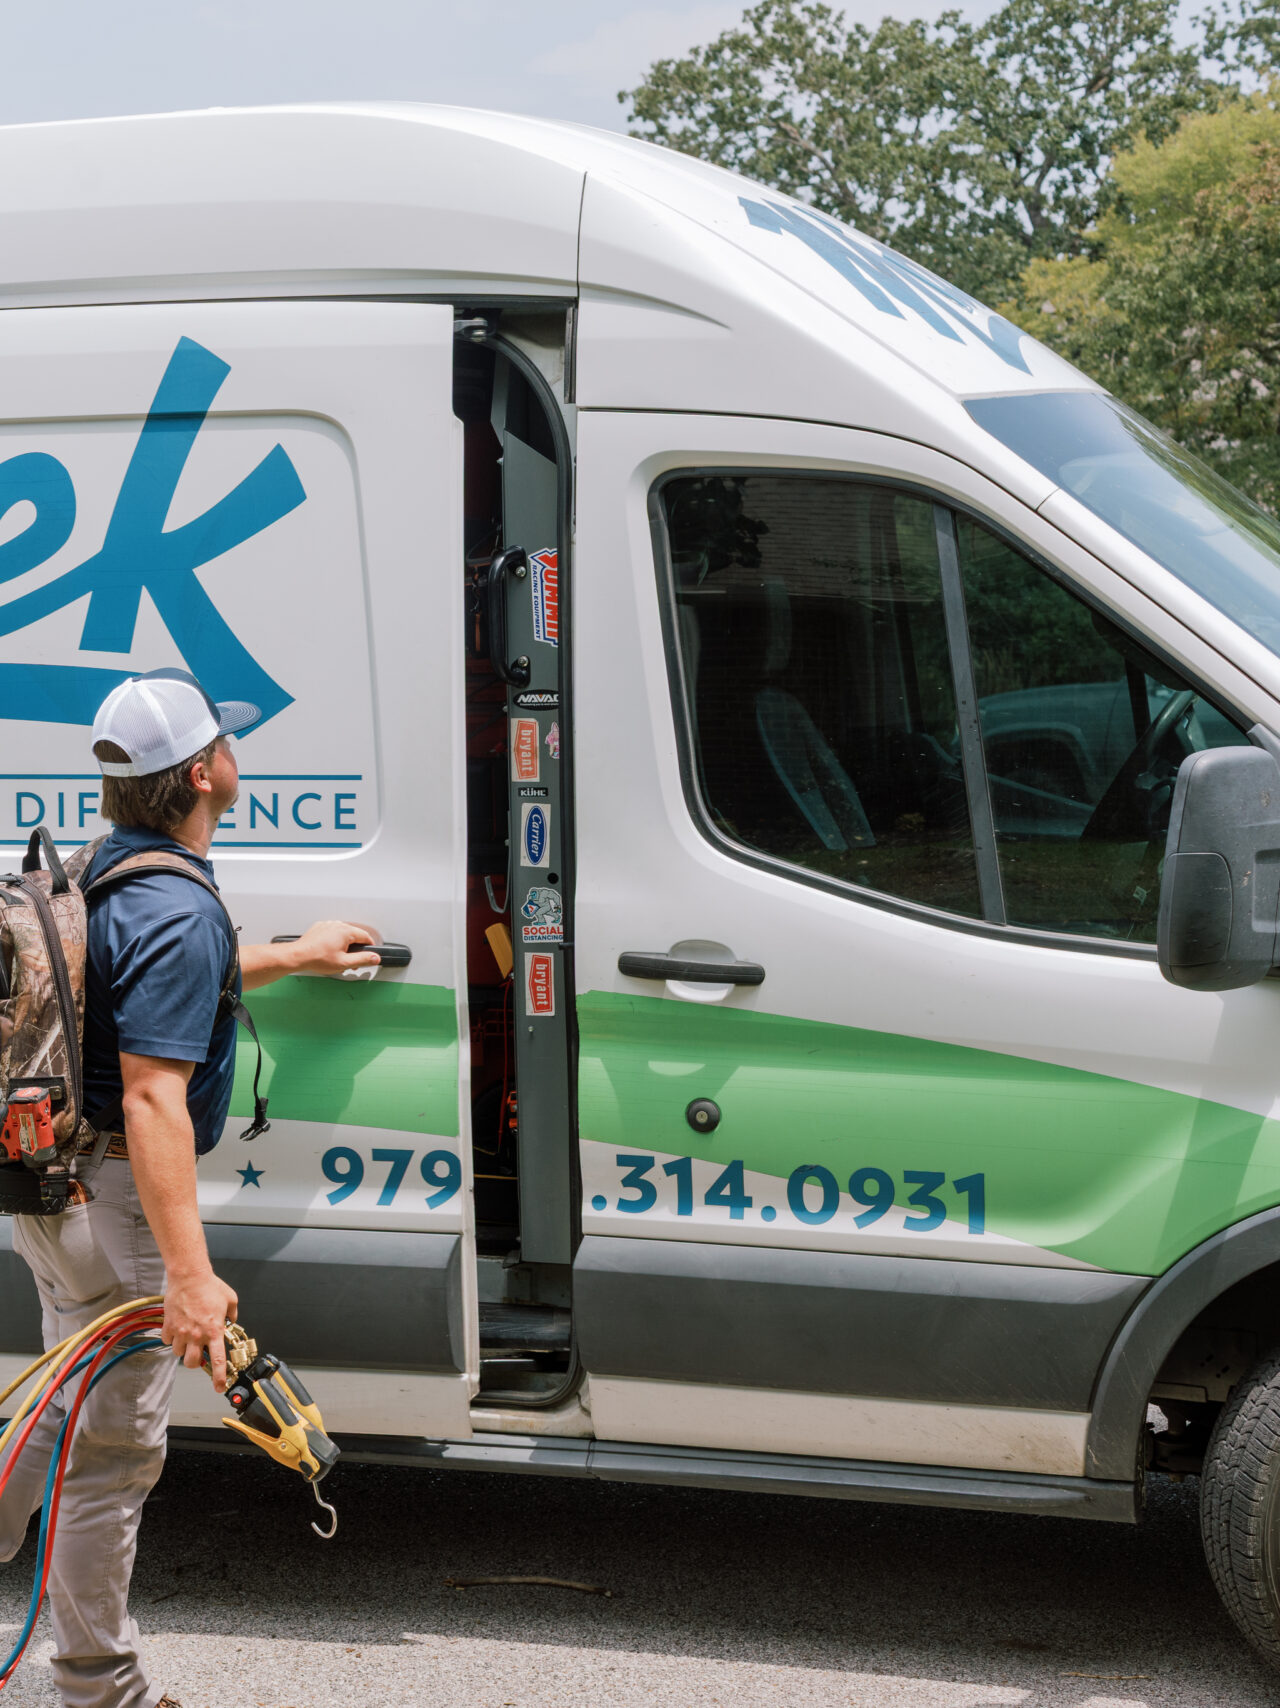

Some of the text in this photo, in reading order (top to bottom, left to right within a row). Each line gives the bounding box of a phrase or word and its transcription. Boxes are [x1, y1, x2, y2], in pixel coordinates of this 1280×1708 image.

[531, 564, 541, 639] RACING EQUIPMENT
[521, 729, 533, 772] bryant
[530, 813, 542, 857] Carrier
[523, 926, 564, 935] SOCIAL
[535, 963, 548, 1006] bryant
[321, 1146, 462, 1210] 979
